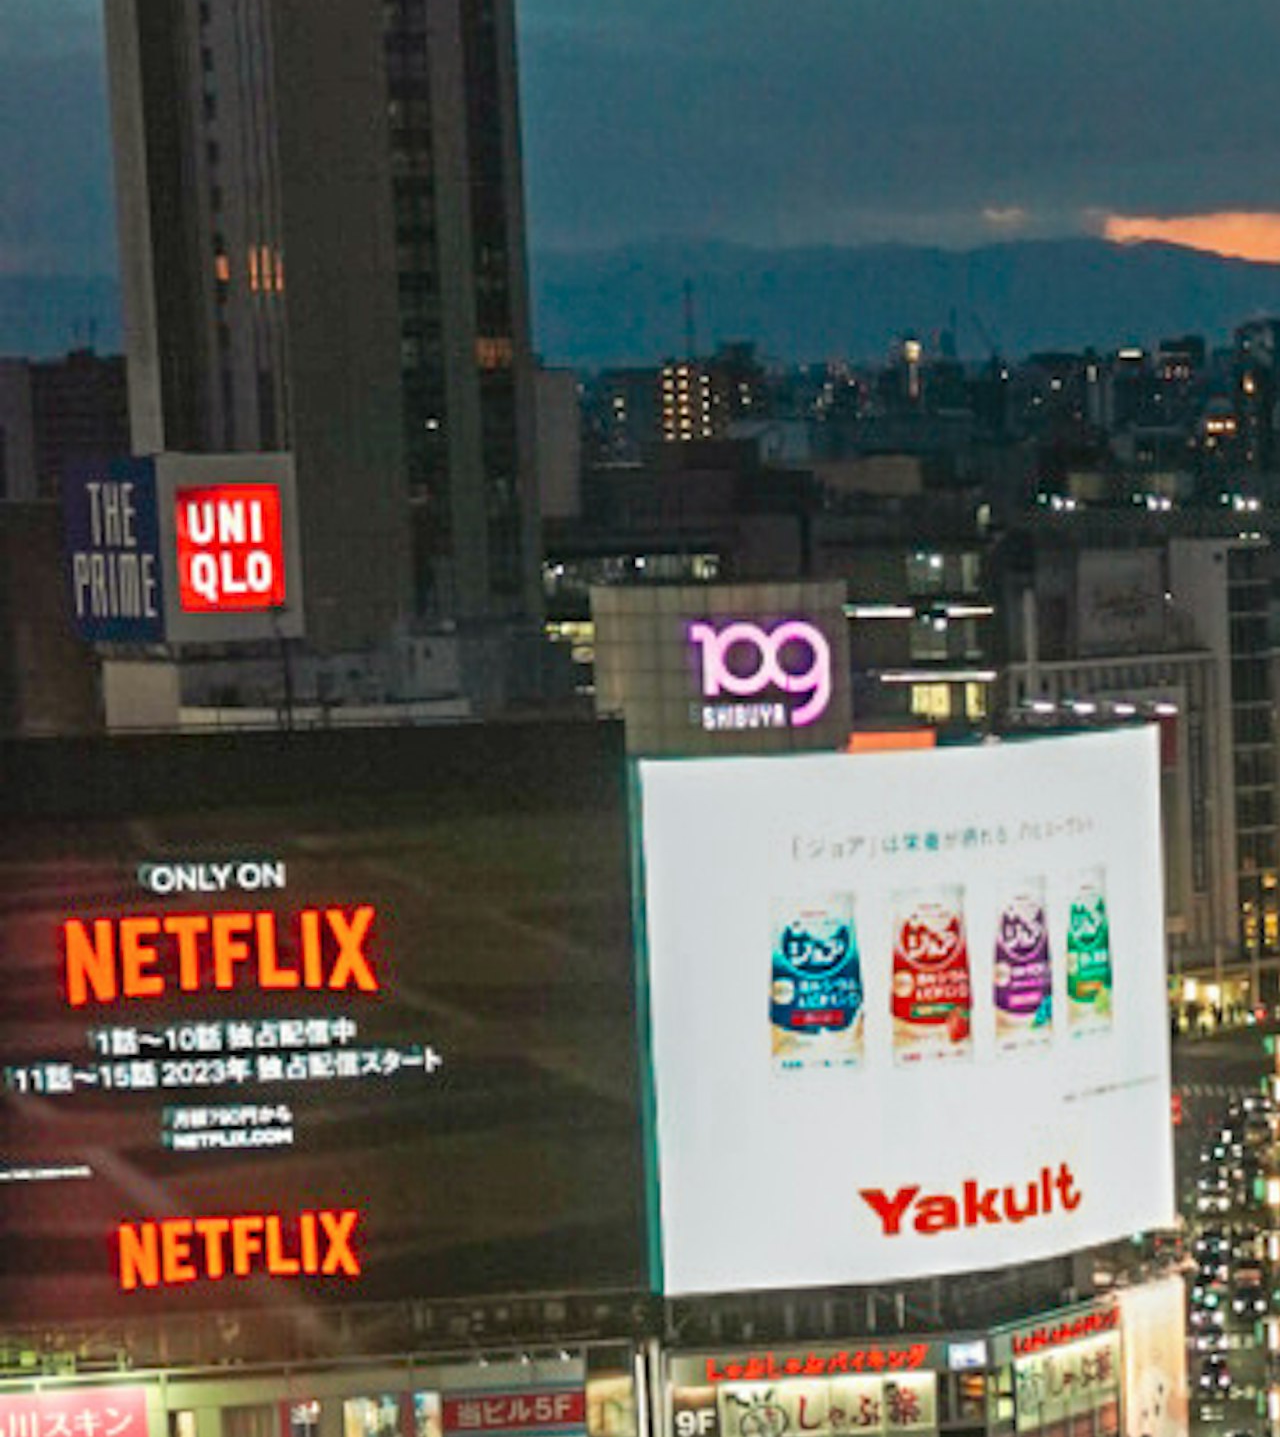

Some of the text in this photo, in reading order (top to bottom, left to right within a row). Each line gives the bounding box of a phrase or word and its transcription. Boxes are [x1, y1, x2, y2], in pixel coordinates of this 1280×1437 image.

[87, 482, 135, 546] THE
[186, 501, 263, 543] UNI
[73, 553, 158, 619] PRIME
[190, 553, 272, 600] QLO
[692, 621, 830, 725] 109
[702, 704, 786, 730] SHIBUYA
[150, 863, 286, 892] ONLY ON
[64, 906, 378, 1006] NETFLIX
[227, 1018, 356, 1048] 独占配信中
[161, 1056, 251, 1085] 2023年
[258, 1047, 442, 1080] 独占配信スタート
[859, 1163, 1082, 1235] Yakult
[117, 1209, 359, 1289] NETFLIX
[456, 1396, 571, 1427] 当ビル5F
